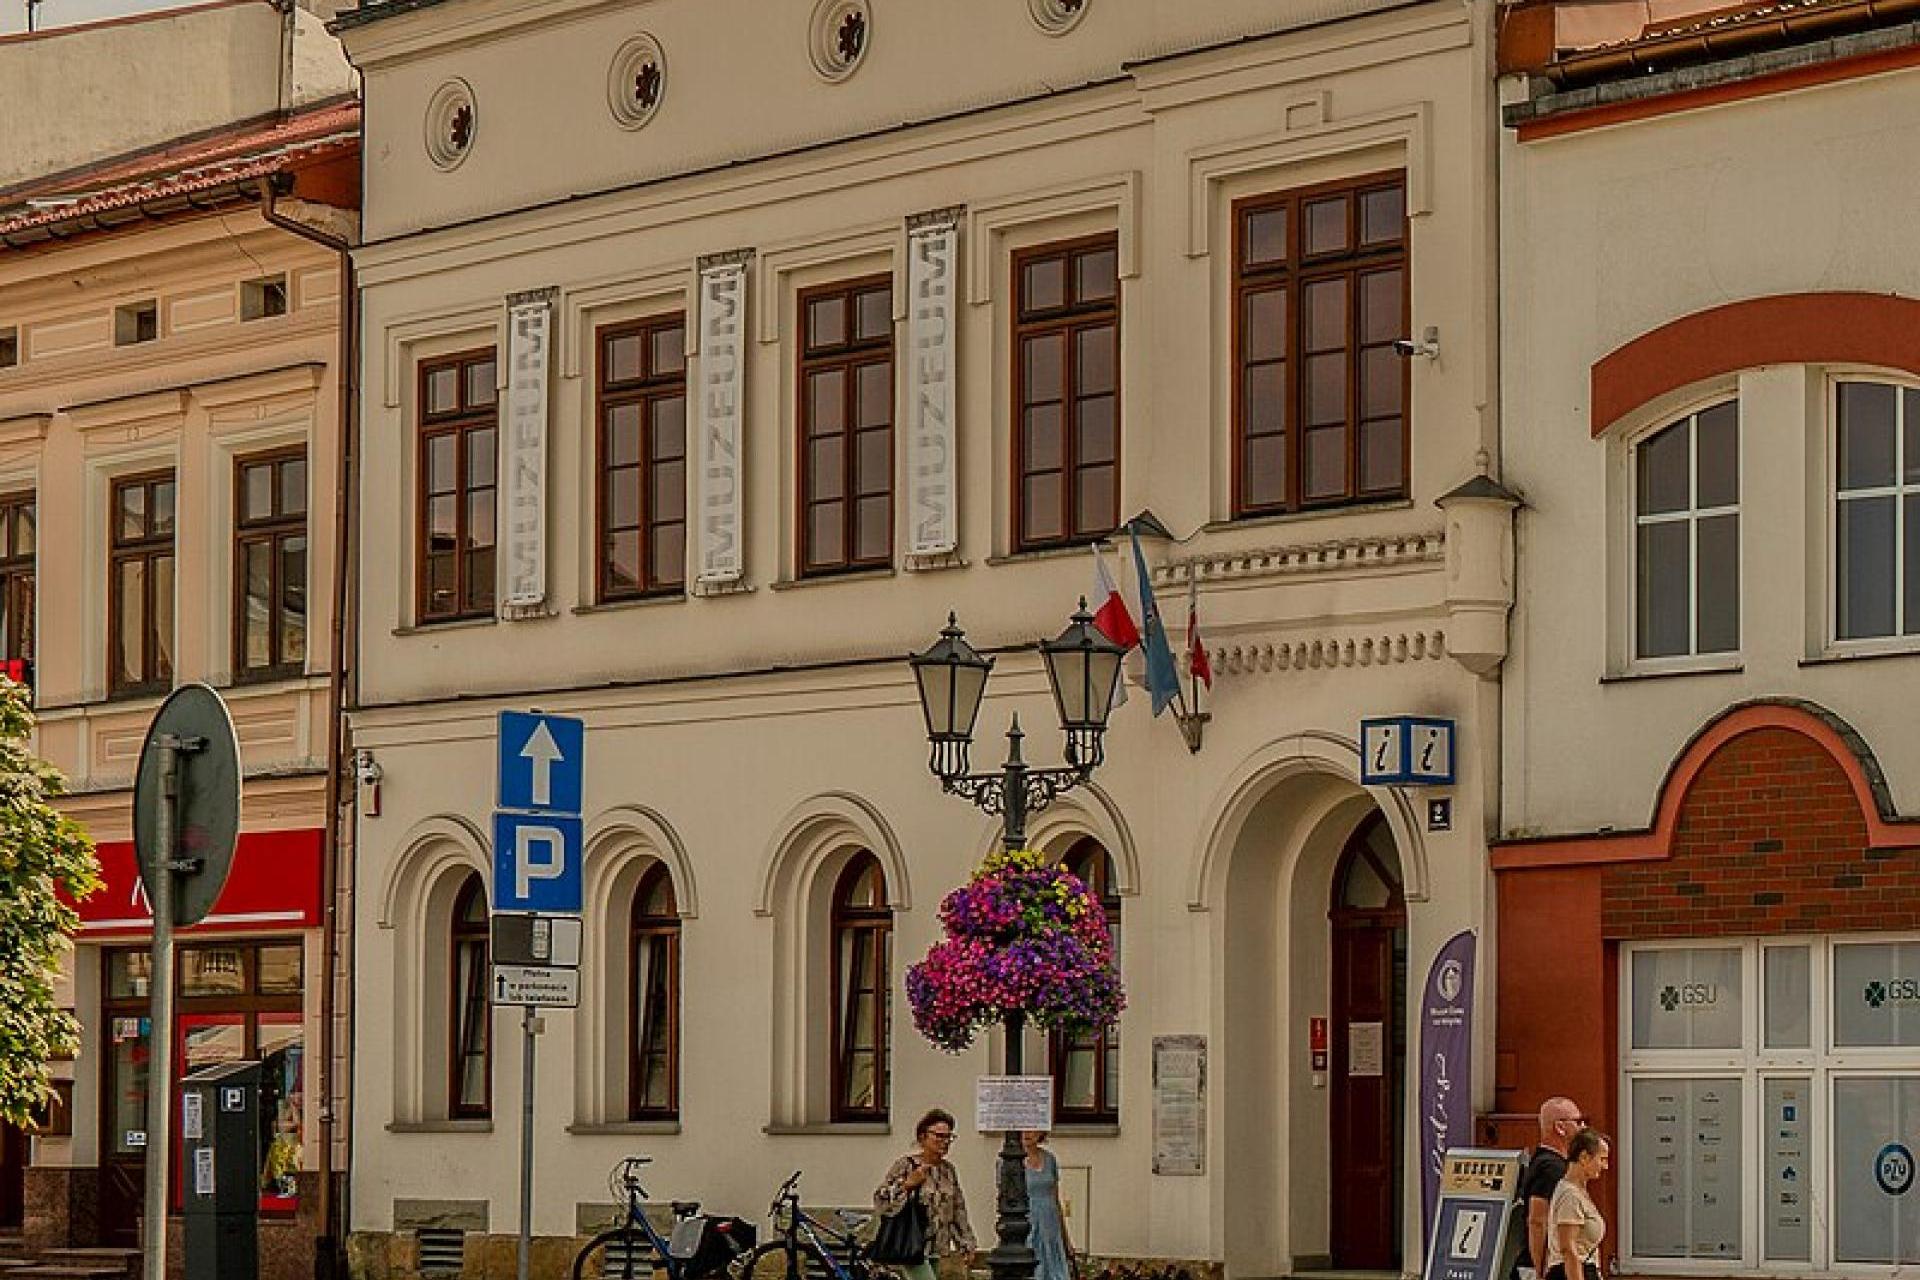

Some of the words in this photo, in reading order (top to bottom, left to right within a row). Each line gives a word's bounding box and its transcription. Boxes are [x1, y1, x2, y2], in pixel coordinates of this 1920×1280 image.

[513, 315, 542, 594] MUZEUM
[704, 280, 736, 570] MUZEUM
[916, 239, 947, 544] MUZEUM
[515, 825, 565, 899] P
[1682, 983, 1717, 1004] GSU
[227, 1089, 241, 1109] P
